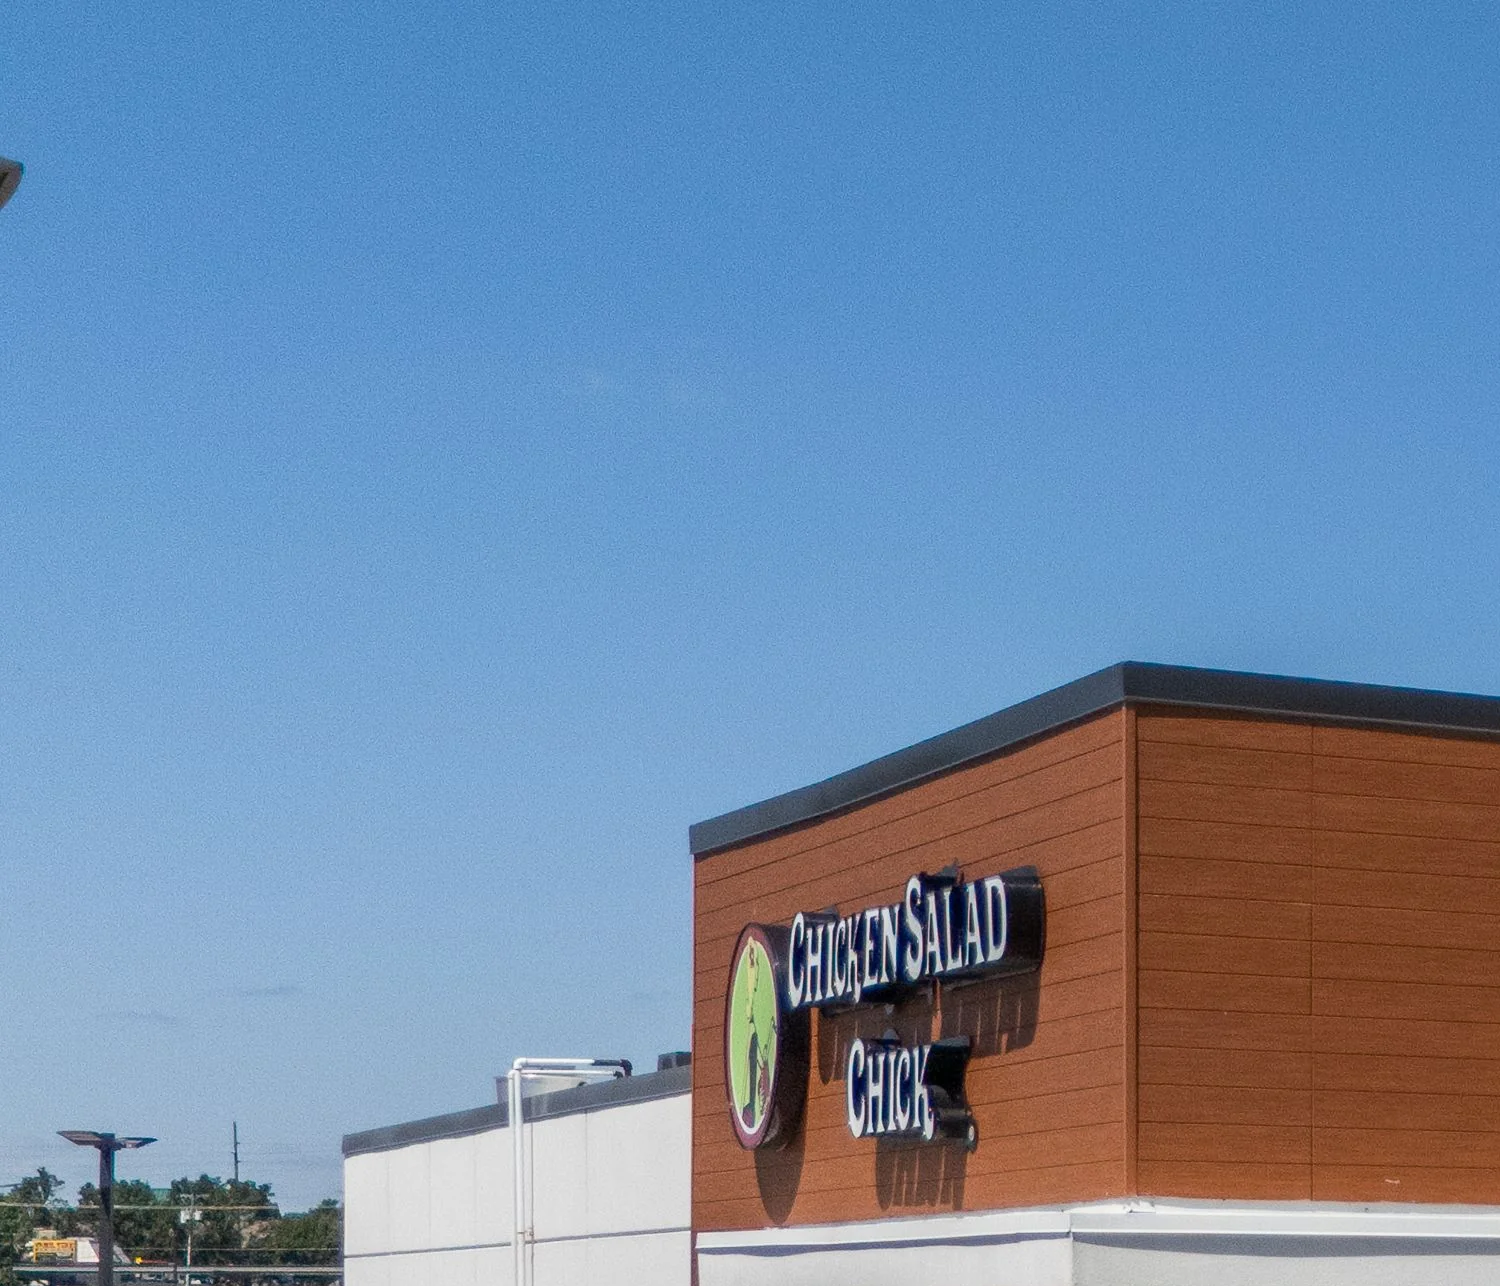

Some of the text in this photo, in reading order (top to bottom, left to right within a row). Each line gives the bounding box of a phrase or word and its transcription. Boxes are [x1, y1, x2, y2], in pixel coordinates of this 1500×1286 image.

[788, 875, 1008, 1007] CHICKEN SALAD
[848, 1038, 935, 1140] CHICK
